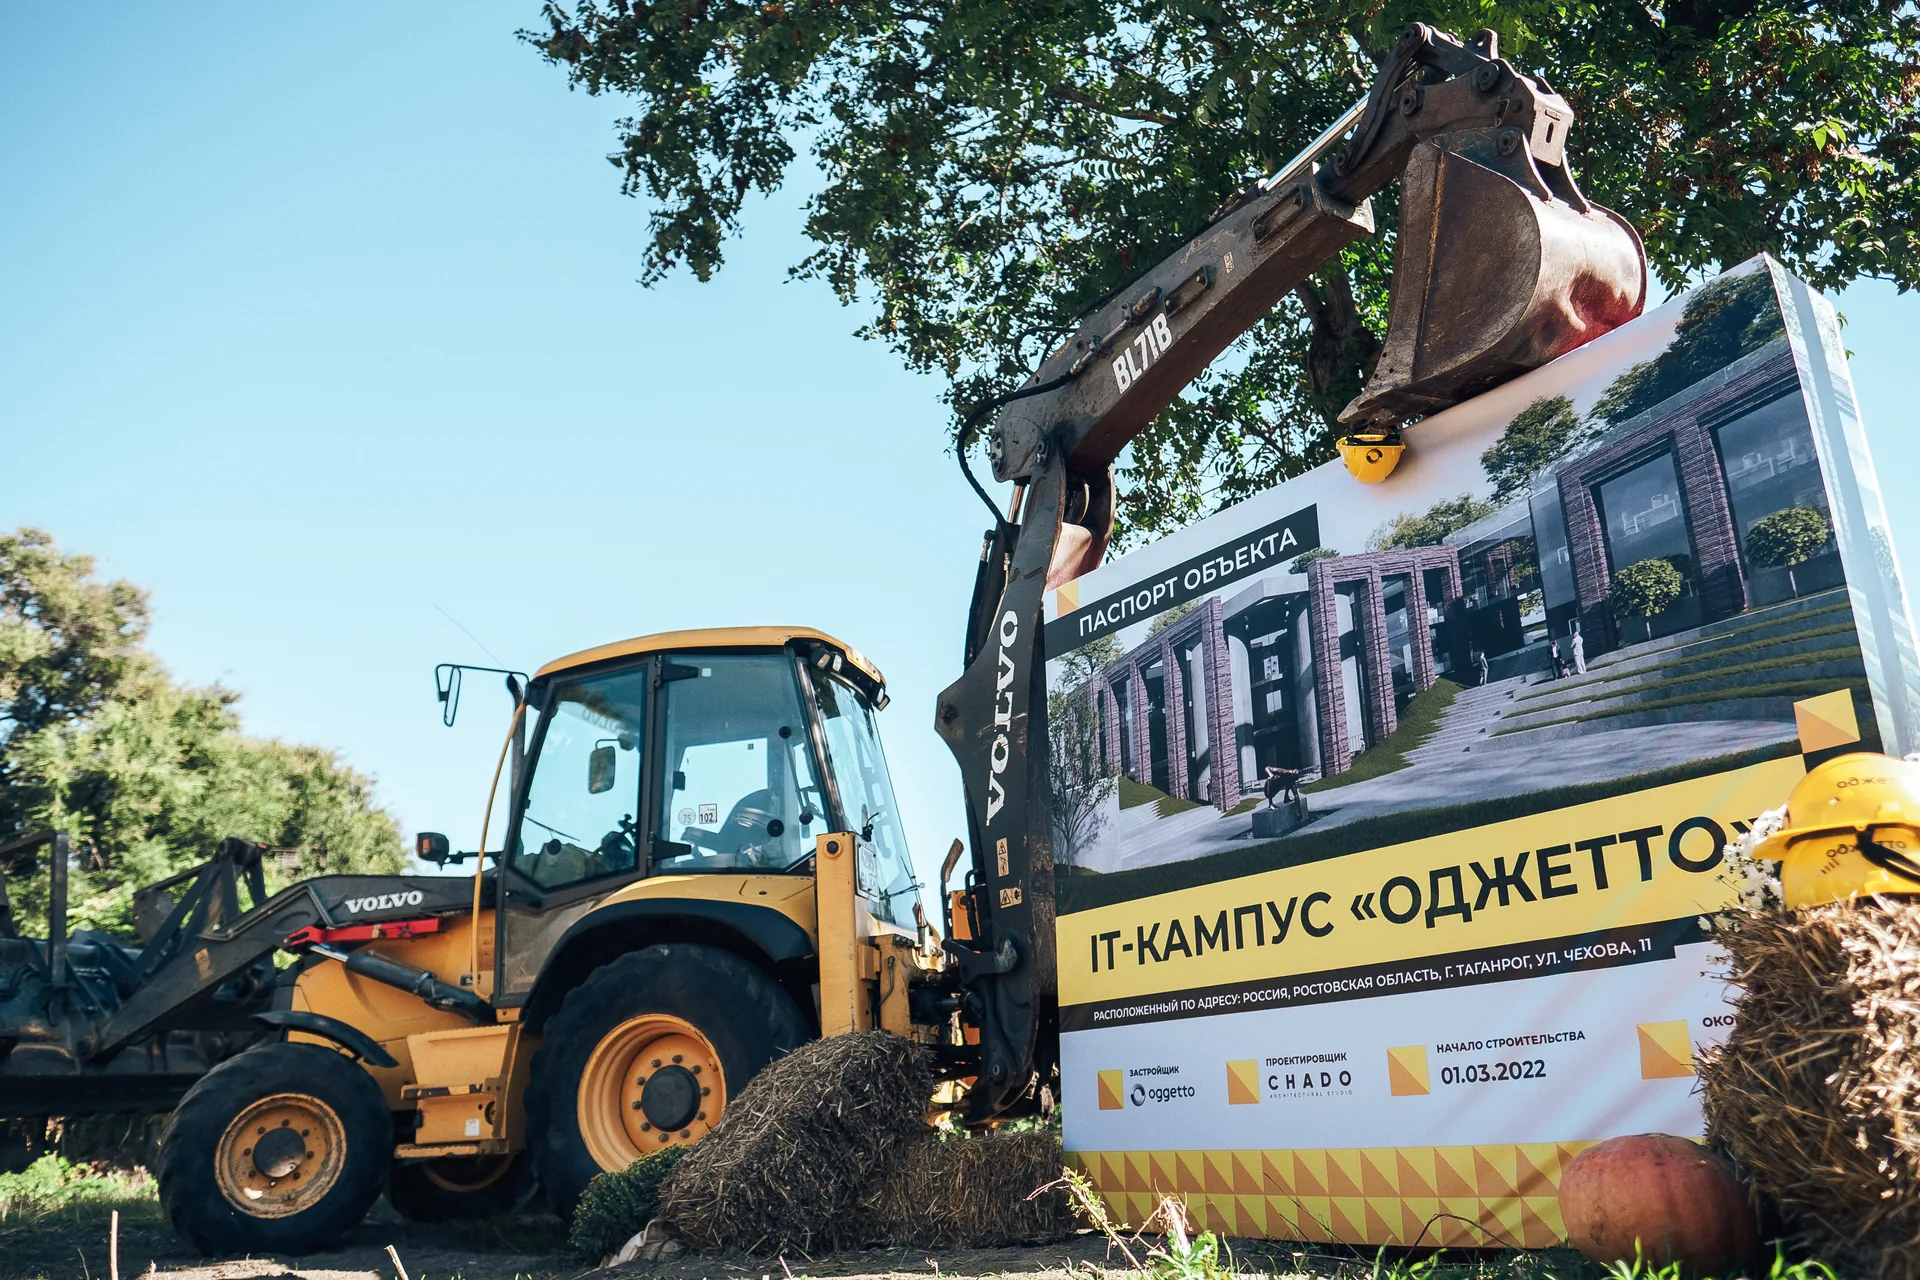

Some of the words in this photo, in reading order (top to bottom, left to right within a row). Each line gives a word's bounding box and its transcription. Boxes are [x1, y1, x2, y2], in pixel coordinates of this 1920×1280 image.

[1112, 312, 1172, 394] BL71B
[1079, 577, 1177, 637] ПАСПОРТ
[1183, 527, 1298, 591] ОБЪЕКТА
[986, 610, 1018, 826] VOLVO
[699, 812, 714, 823] 102
[344, 890, 423, 914] VOLVO
[1091, 891, 1334, 973] IT-КАМПУС
[1093, 999, 1178, 1021] РАСПОЛОЖЕННЫЙ
[1181, 999, 1196, 1010] ПО
[1198, 993, 1241, 1010] АДРЕСУ:
[1243, 987, 1291, 1004] РОССИЯ,
[1293, 976, 1373, 997] РОСТОВСКАЯ
[1376, 968, 1442, 987] ОБЛАСТЬ,
[1445, 966, 1454, 978] Г.
[1456, 955, 1533, 977] ТАГАНРОГ,
[1535, 951, 1561, 967] УЛ.
[1564, 940, 1637, 962] ЧЕХОВА,
[1639, 937, 1652, 951] 11
[1702, 1015, 1735, 1028] ОКО
[1436, 1041, 1483, 1053] НАЧАЛО
[1486, 1030, 1586, 1049] СТРОИТЕЛЬСТВА
[1129, 1065, 1180, 1077] ЗАСТРОЙЩИК
[1266, 1052, 1348, 1067] ПРОЕКТИРОВЩИК
[1268, 1070, 1352, 1091] CHADO
[1441, 1059, 1547, 1085] 01.03.2022
[1148, 1085, 1195, 1103] oggetto
[1327, 1089, 1353, 1097] STUDIO
